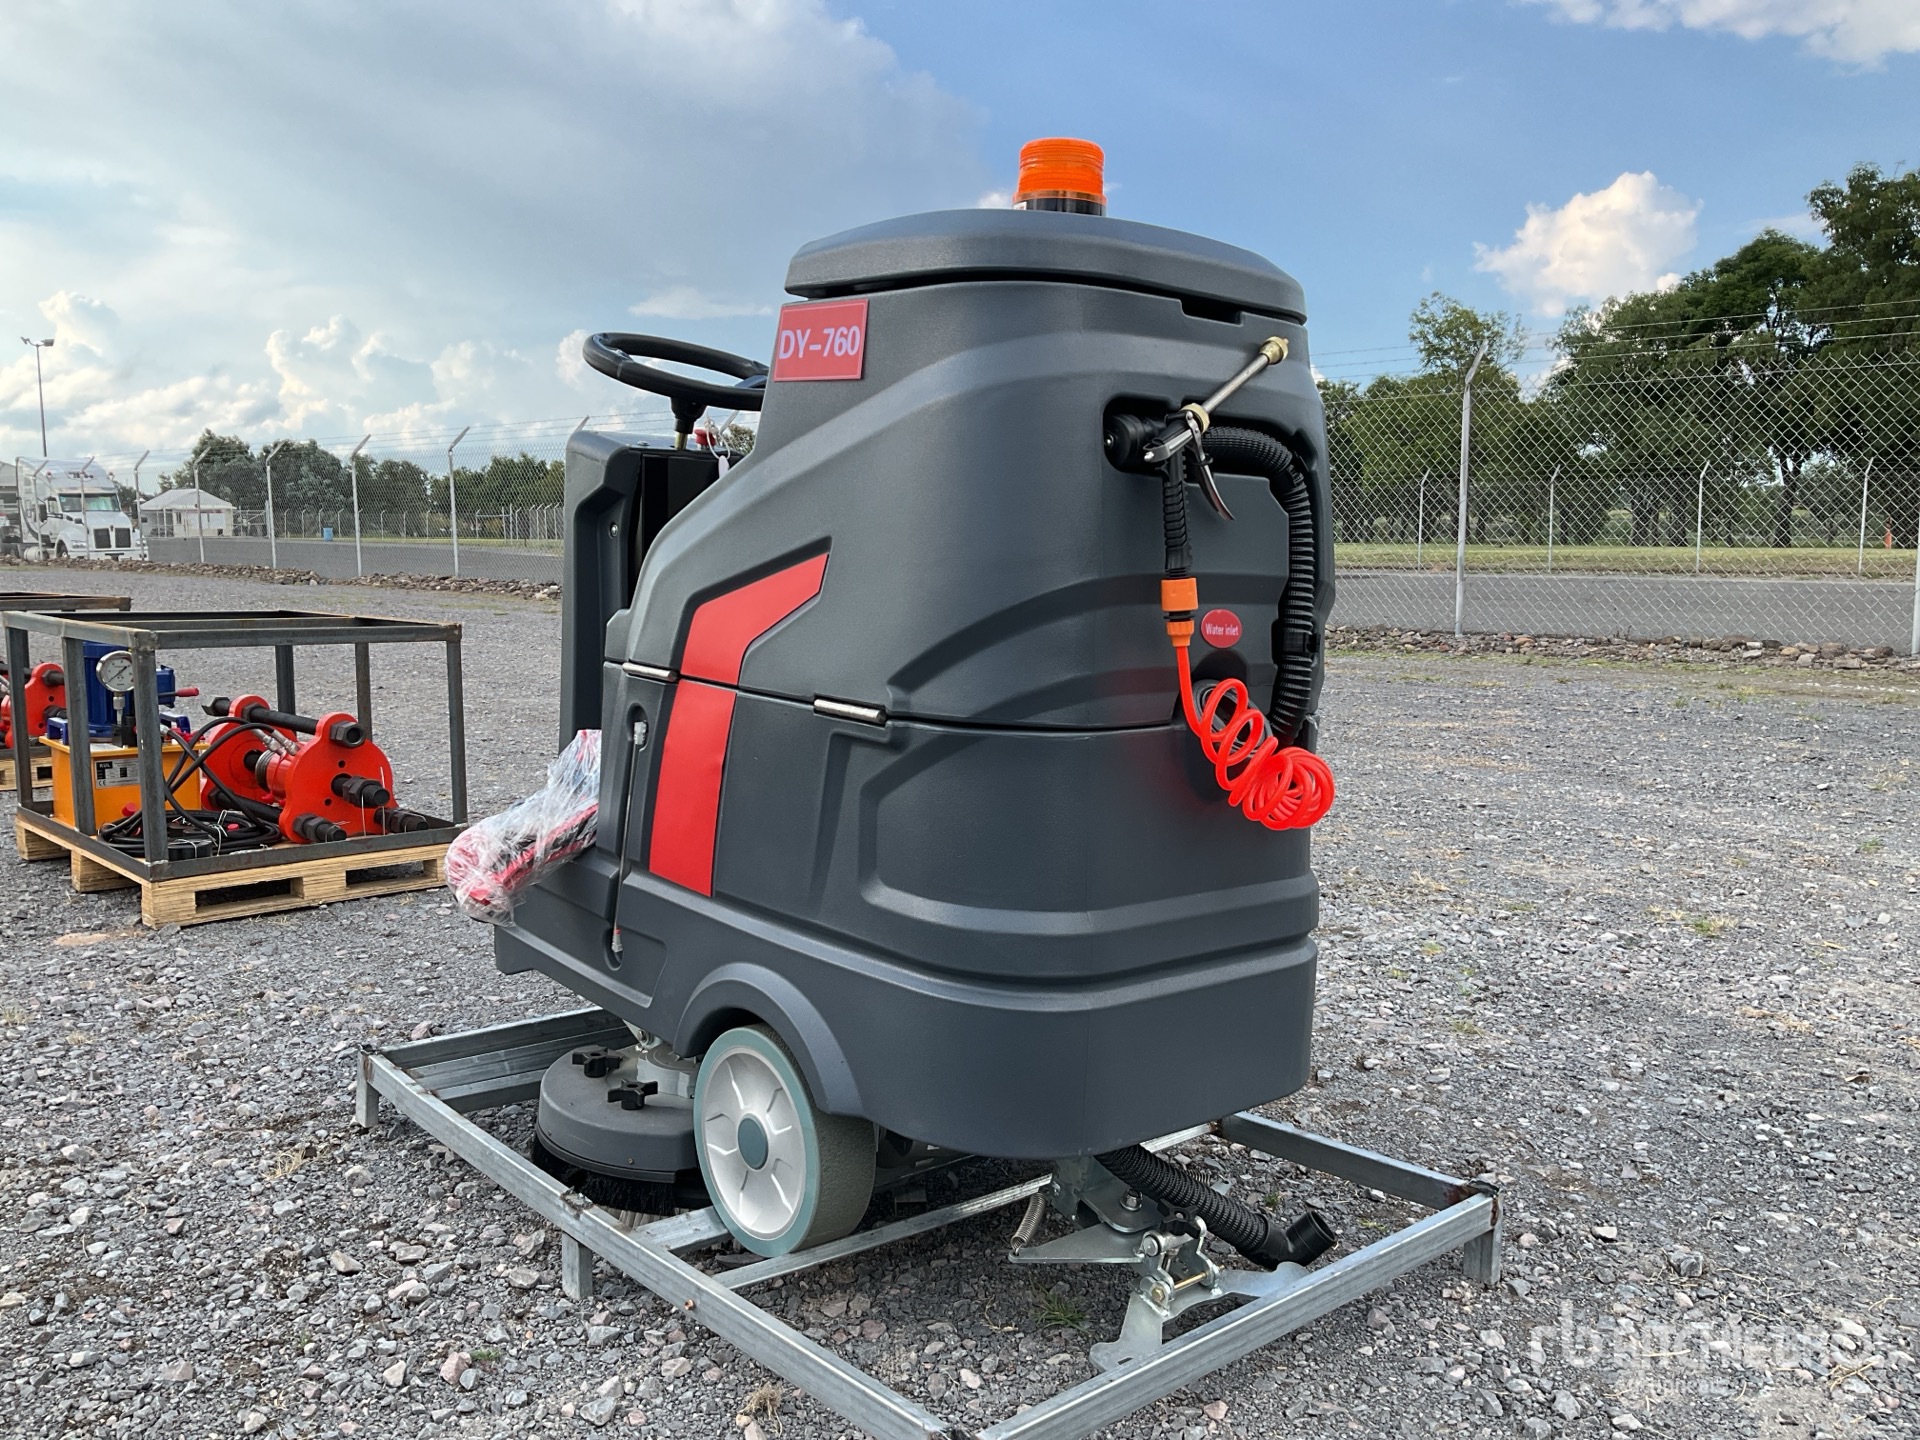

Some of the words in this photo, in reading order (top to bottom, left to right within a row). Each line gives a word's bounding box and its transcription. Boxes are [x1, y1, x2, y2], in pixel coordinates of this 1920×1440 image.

[779, 325, 861, 359] DY-760
[1205, 623, 1224, 636] Water
[1225, 624, 1239, 636] inlet
